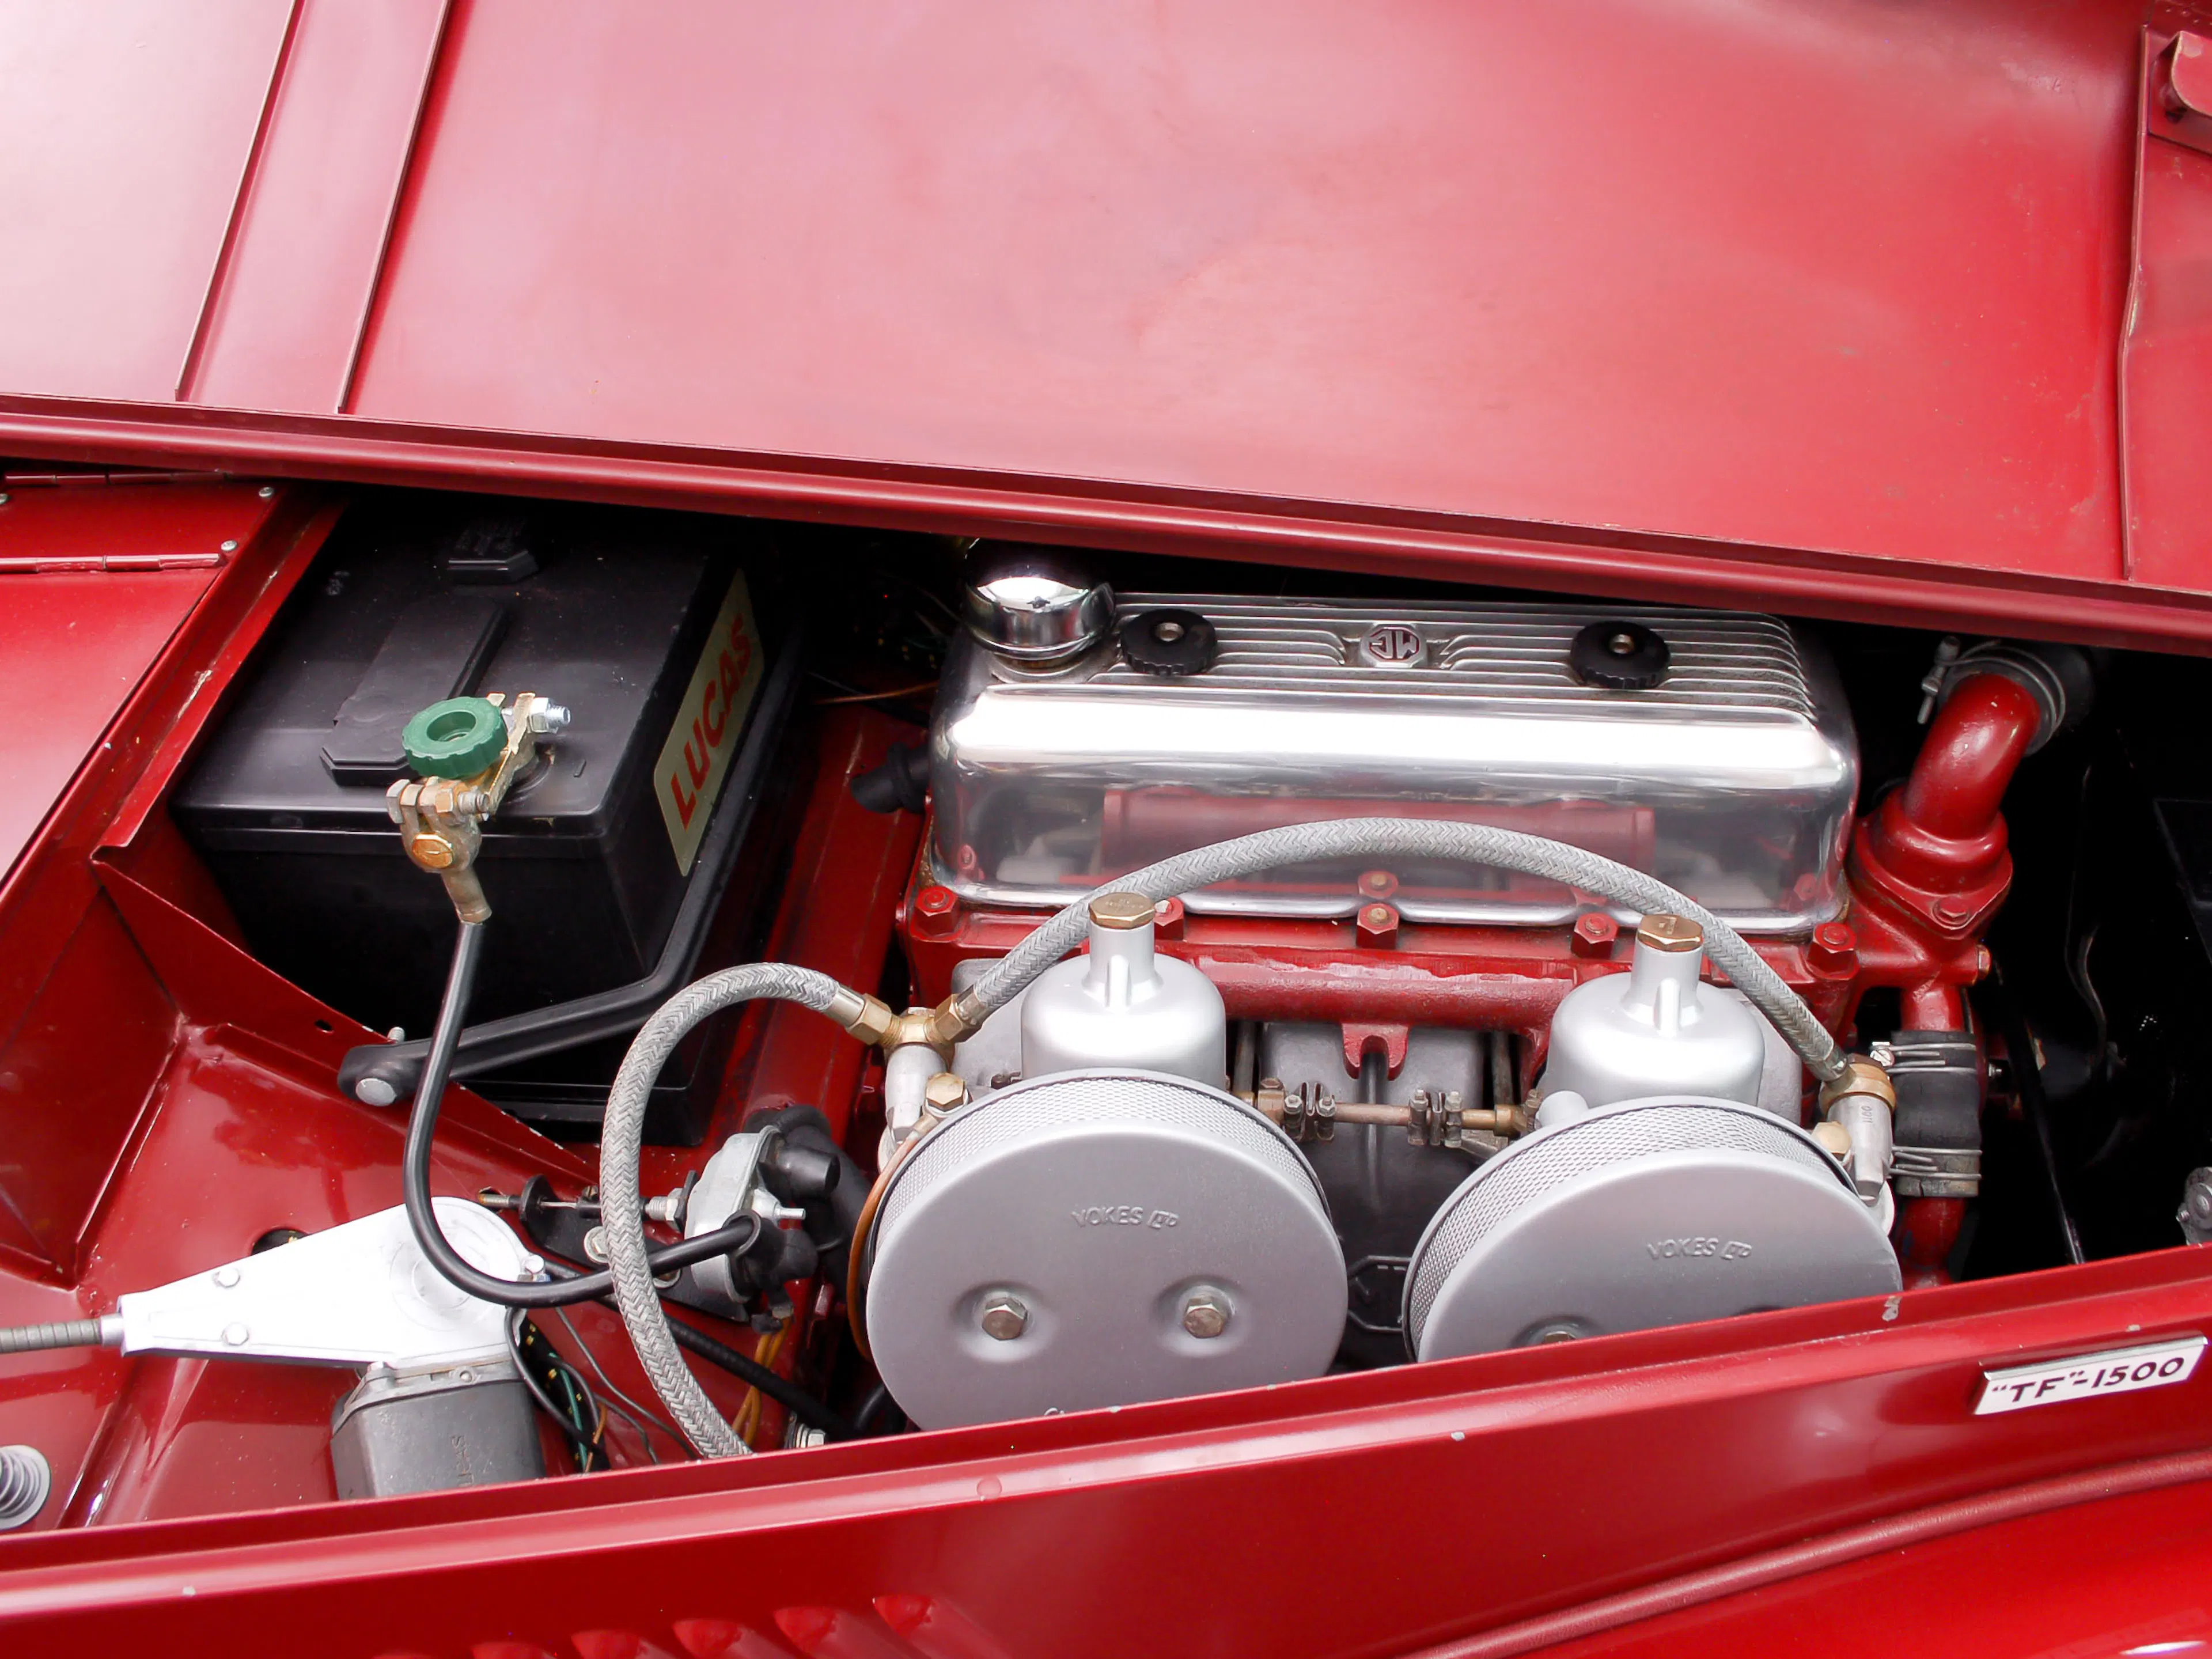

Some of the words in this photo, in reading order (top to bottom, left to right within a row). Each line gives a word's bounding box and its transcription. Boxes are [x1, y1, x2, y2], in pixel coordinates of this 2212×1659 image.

[670, 612, 752, 831] LUCAS
[1070, 1205, 1143, 1228] VOKES
[1646, 1237, 1719, 1261] VOKES
